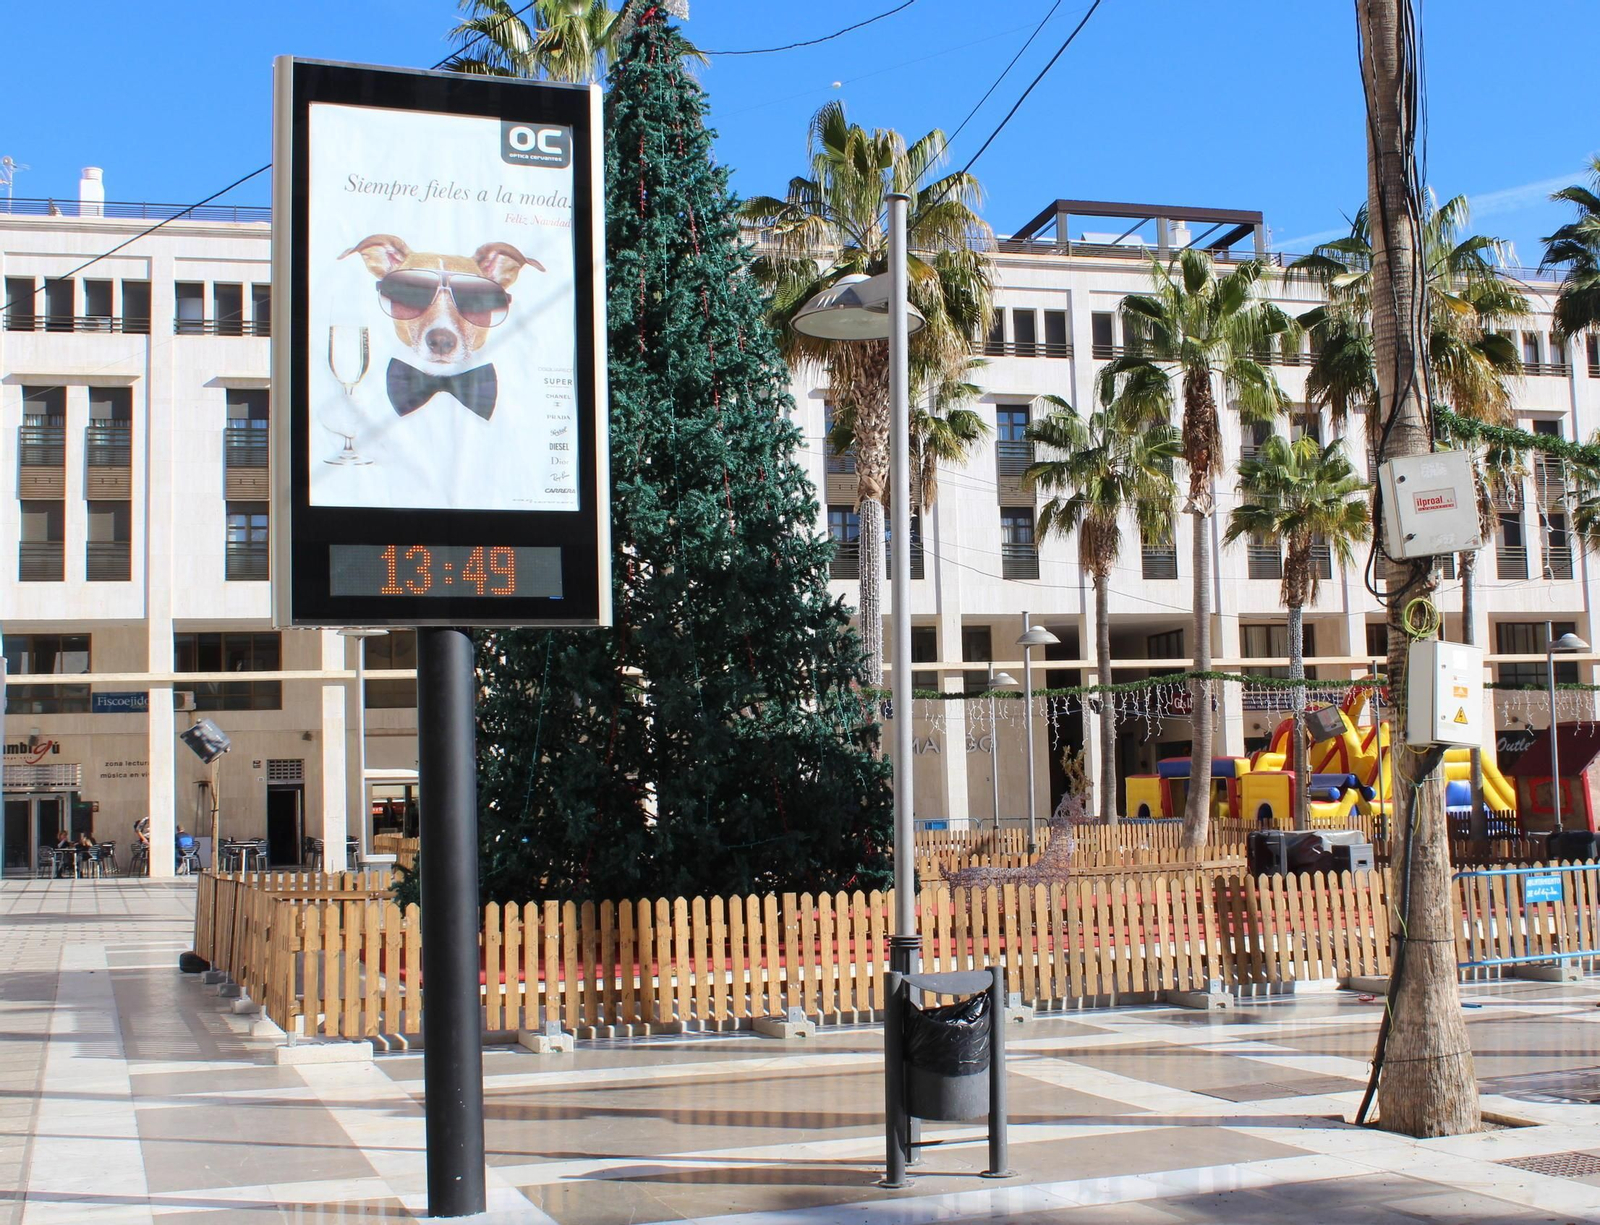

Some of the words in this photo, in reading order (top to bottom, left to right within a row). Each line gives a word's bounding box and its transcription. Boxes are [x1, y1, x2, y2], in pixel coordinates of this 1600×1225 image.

[509, 126, 563, 155] OC
[344, 173, 419, 201] Siempre
[419, 179, 471, 203] fieles
[476, 188, 489, 201] a
[495, 185, 513, 203] la
[519, 190, 572, 209] moda.
[504, 213, 528, 226] Feliz
[530, 215, 571, 228] Navidad
[543, 377, 573, 386] SUPER
[549, 442, 569, 451] DIESEL
[551, 456, 569, 465] Dior
[1416, 495, 1443, 507] ilproal
[381, 545, 515, 595] 13:49
[3, 740, 60, 764] mbigú
[1497, 737, 1537, 752] Outle
